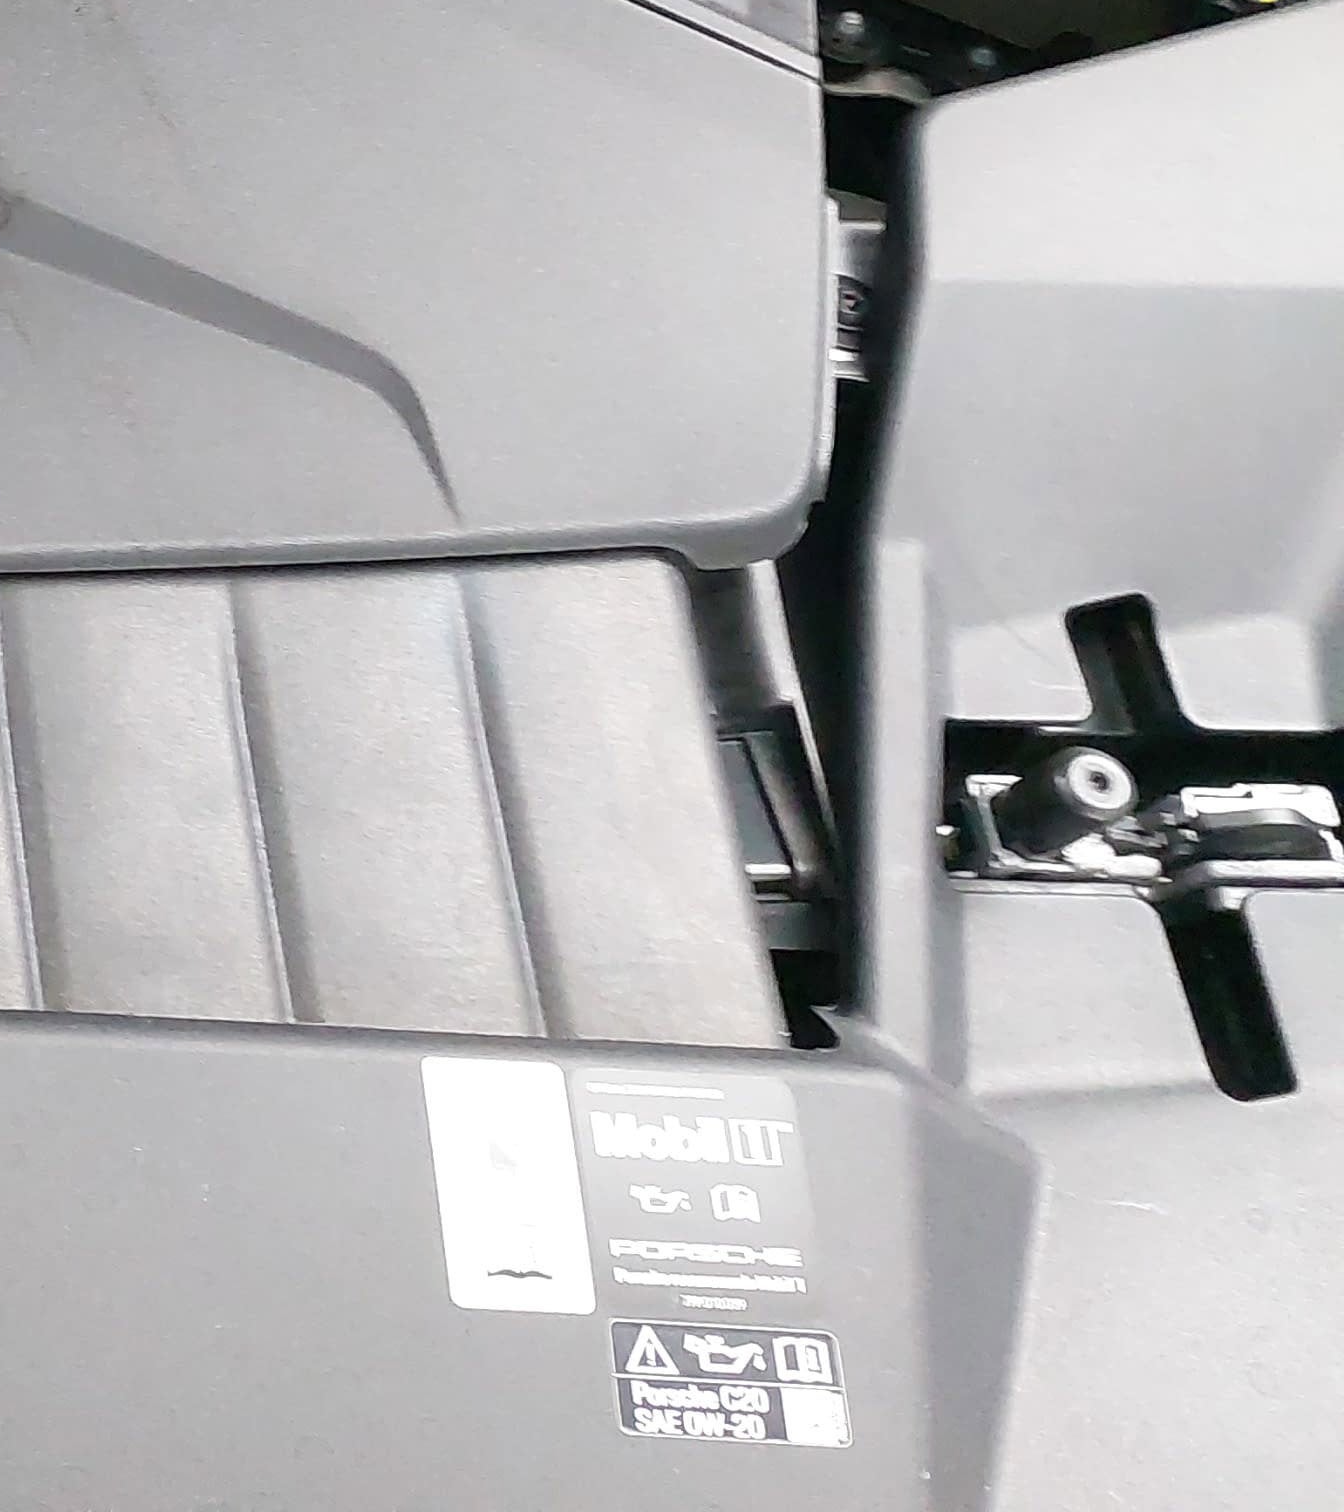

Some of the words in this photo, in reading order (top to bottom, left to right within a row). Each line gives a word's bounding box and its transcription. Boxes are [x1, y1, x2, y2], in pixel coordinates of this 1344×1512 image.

[589, 1110, 730, 1163] Mobil
[609, 1238, 804, 1268] PORSCHE
[630, 1380, 720, 1410] Porsche
[719, 1385, 770, 1413] C20
[633, 1407, 684, 1435] SAE
[682, 1410, 766, 1439] 0W-20
